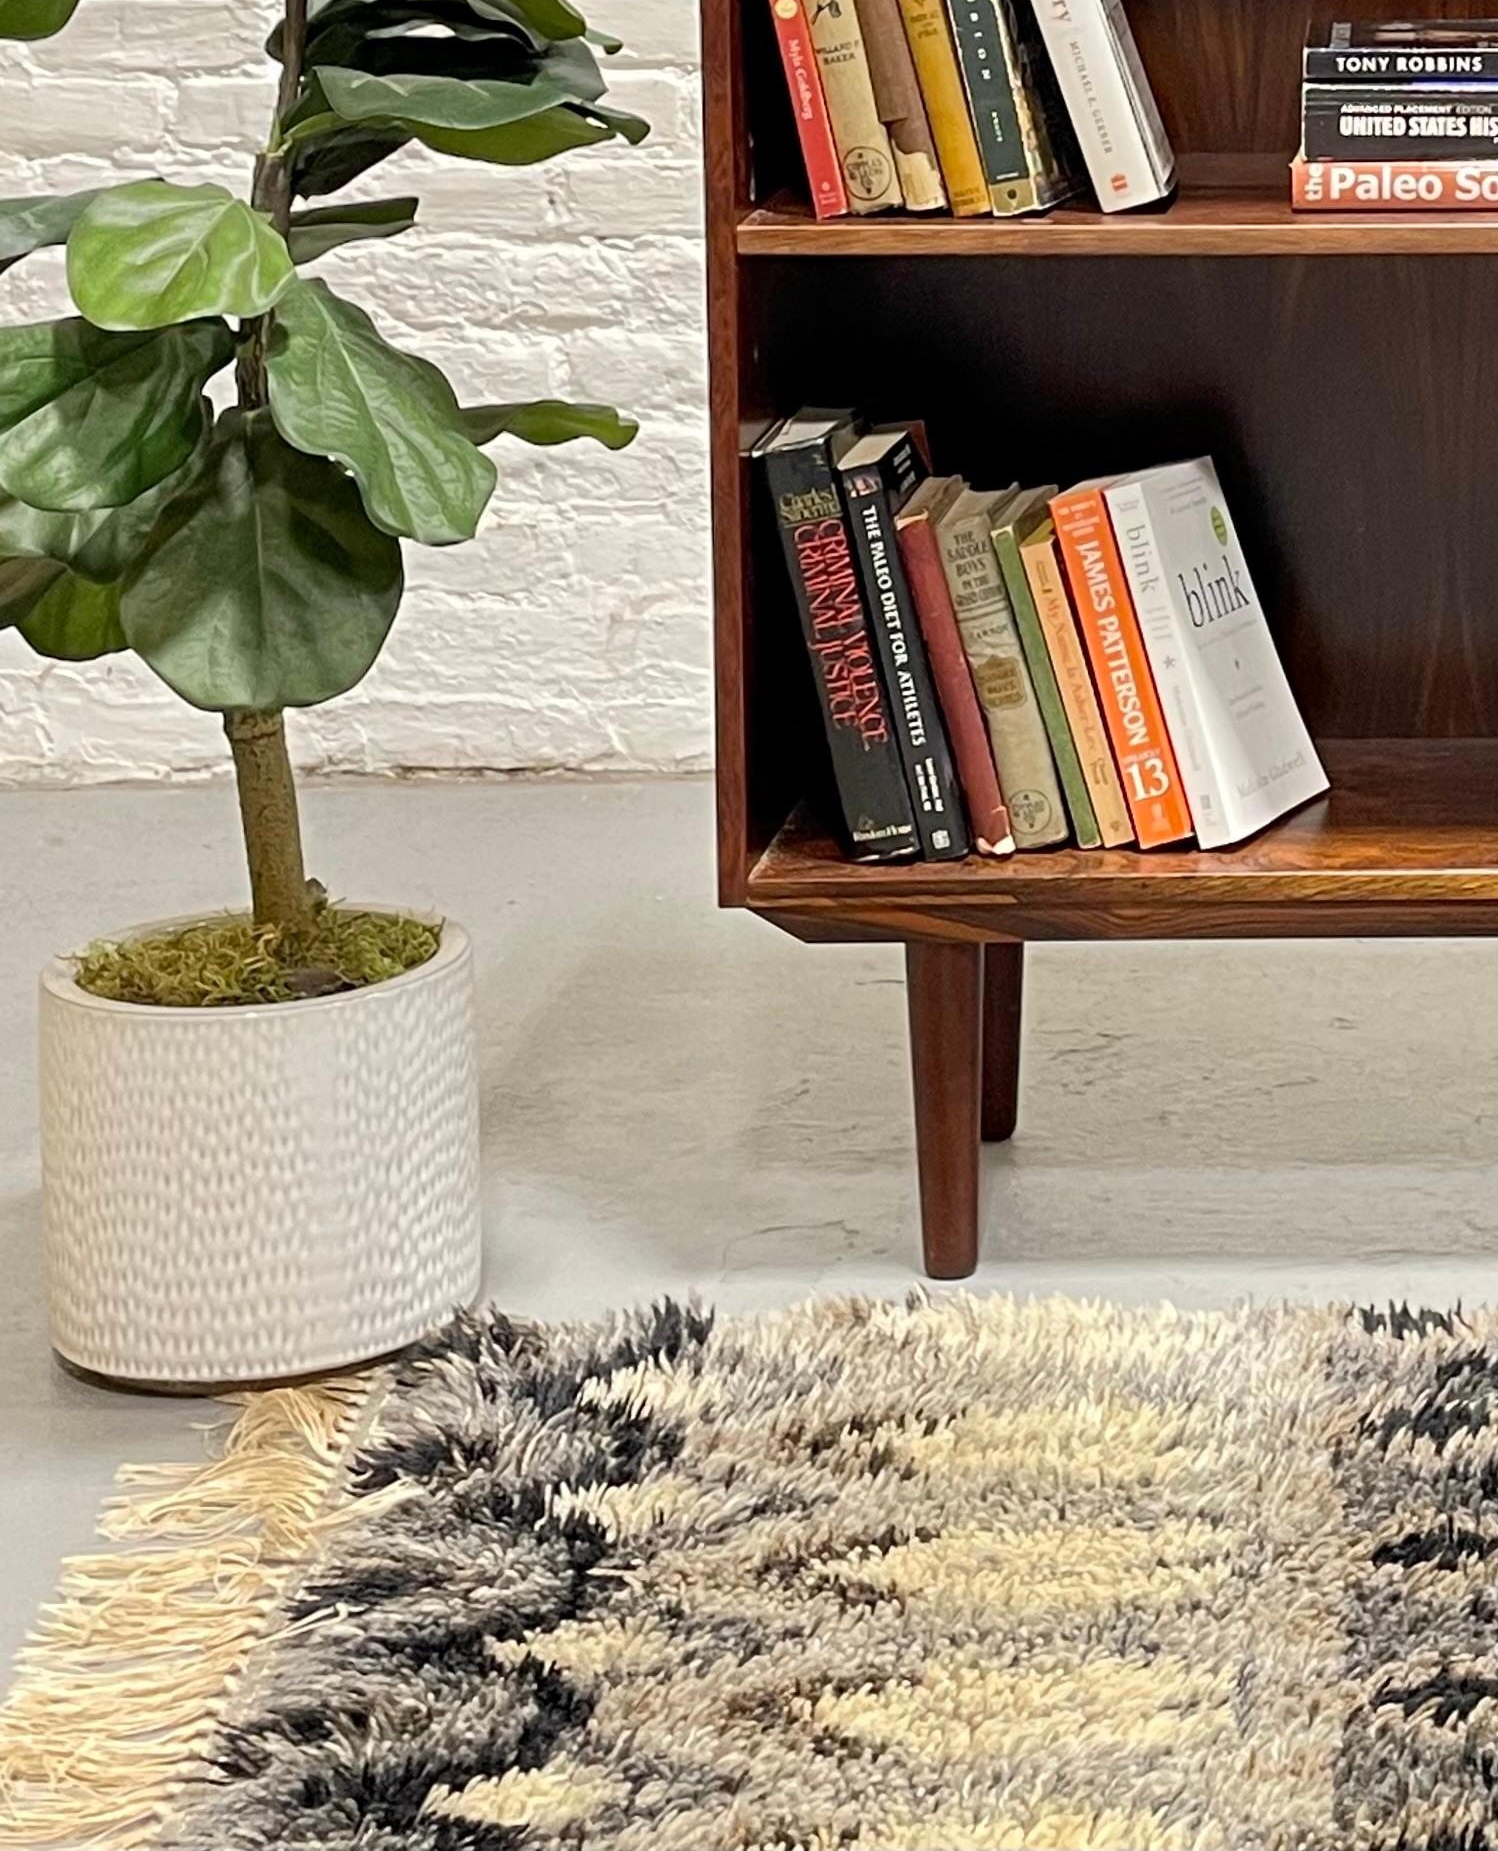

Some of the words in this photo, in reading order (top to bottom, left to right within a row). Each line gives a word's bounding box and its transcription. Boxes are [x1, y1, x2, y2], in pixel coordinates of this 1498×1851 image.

[1336, 57, 1390, 72] TONY
[1396, 56, 1483, 72] ROBBINS
[1339, 116, 1406, 136] UNITED
[1408, 116, 1467, 137] STATES
[1330, 166, 1443, 201] Paleo
[862, 504, 881, 540] THE
[794, 525, 841, 639] CRIMINAL
[870, 541, 893, 589] PALEO
[1127, 524, 1160, 593] blink
[880, 592, 902, 628] DIET
[1178, 555, 1250, 628] blink
[818, 519, 864, 628] CRIMINAL
[843, 630, 888, 752] VIOLENCE
[889, 631, 908, 667] FOR
[1075, 541, 1116, 613] JAMES
[1098, 616, 1151, 747] PATTERSON
[807, 641, 857, 730] JUSTICE
[897, 670, 926, 747] ATHLETES
[1126, 757, 1170, 802] 13
